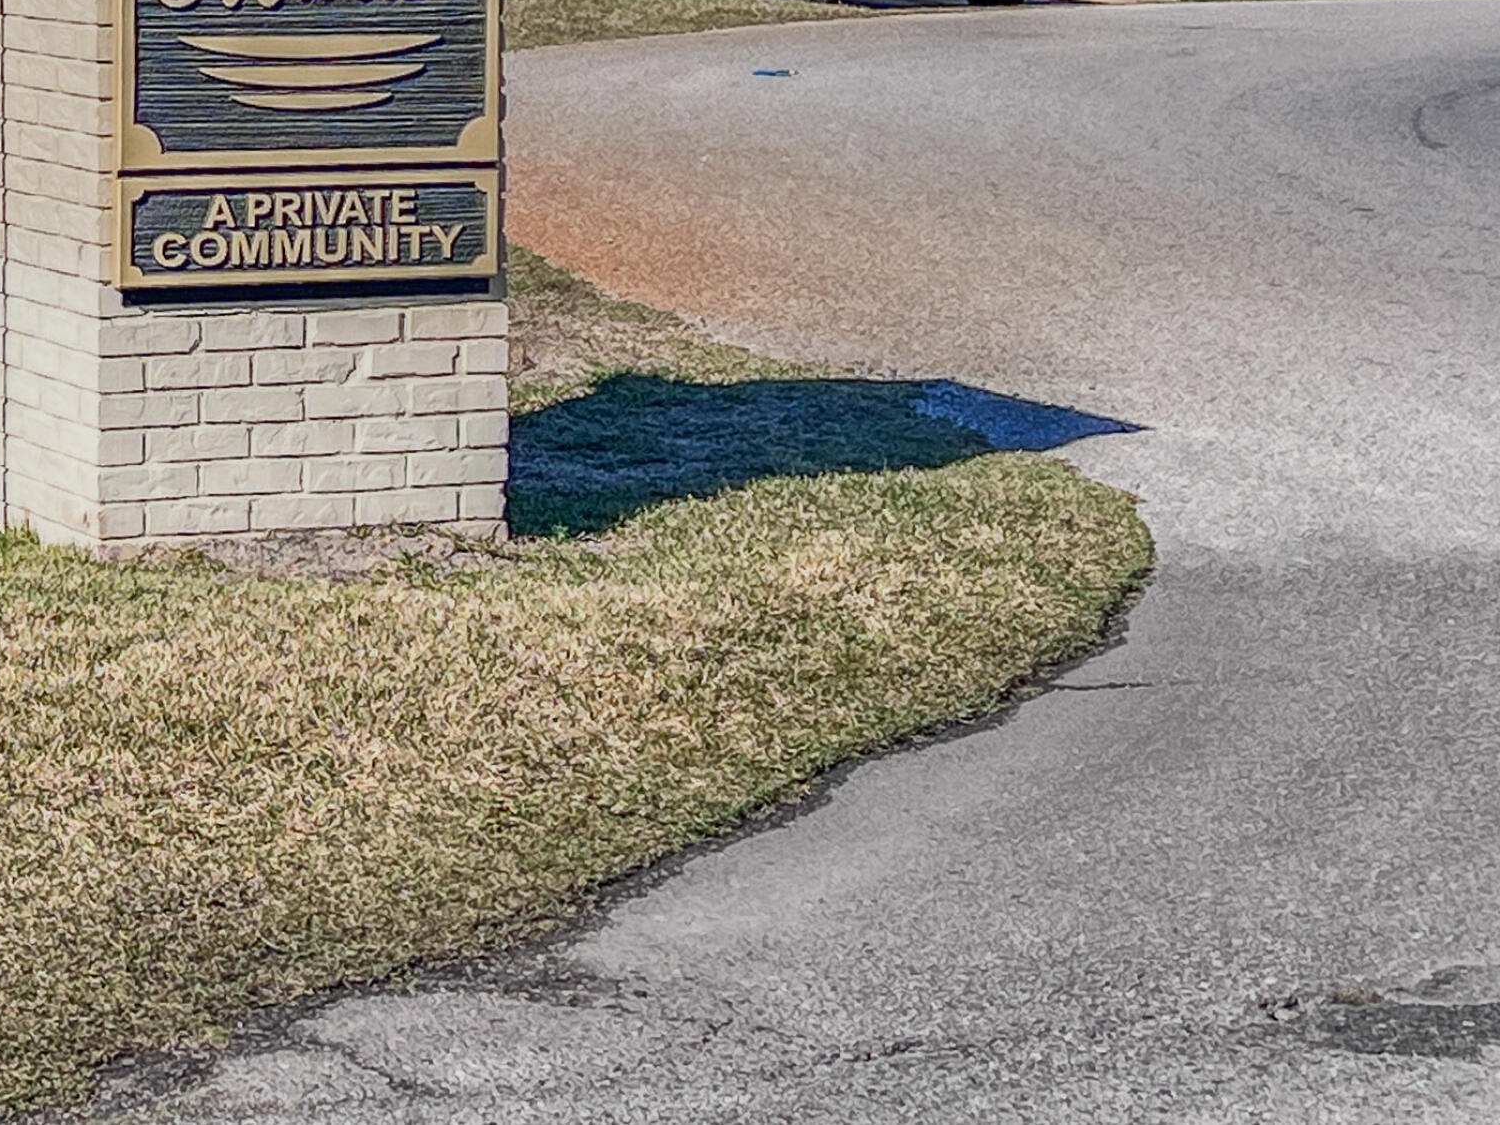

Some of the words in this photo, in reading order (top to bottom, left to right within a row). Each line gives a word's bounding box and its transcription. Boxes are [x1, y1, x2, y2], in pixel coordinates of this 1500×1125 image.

[205, 192, 236, 229] A
[247, 188, 417, 228] PRIVATE
[153, 223, 465, 267] COMMUNITY
